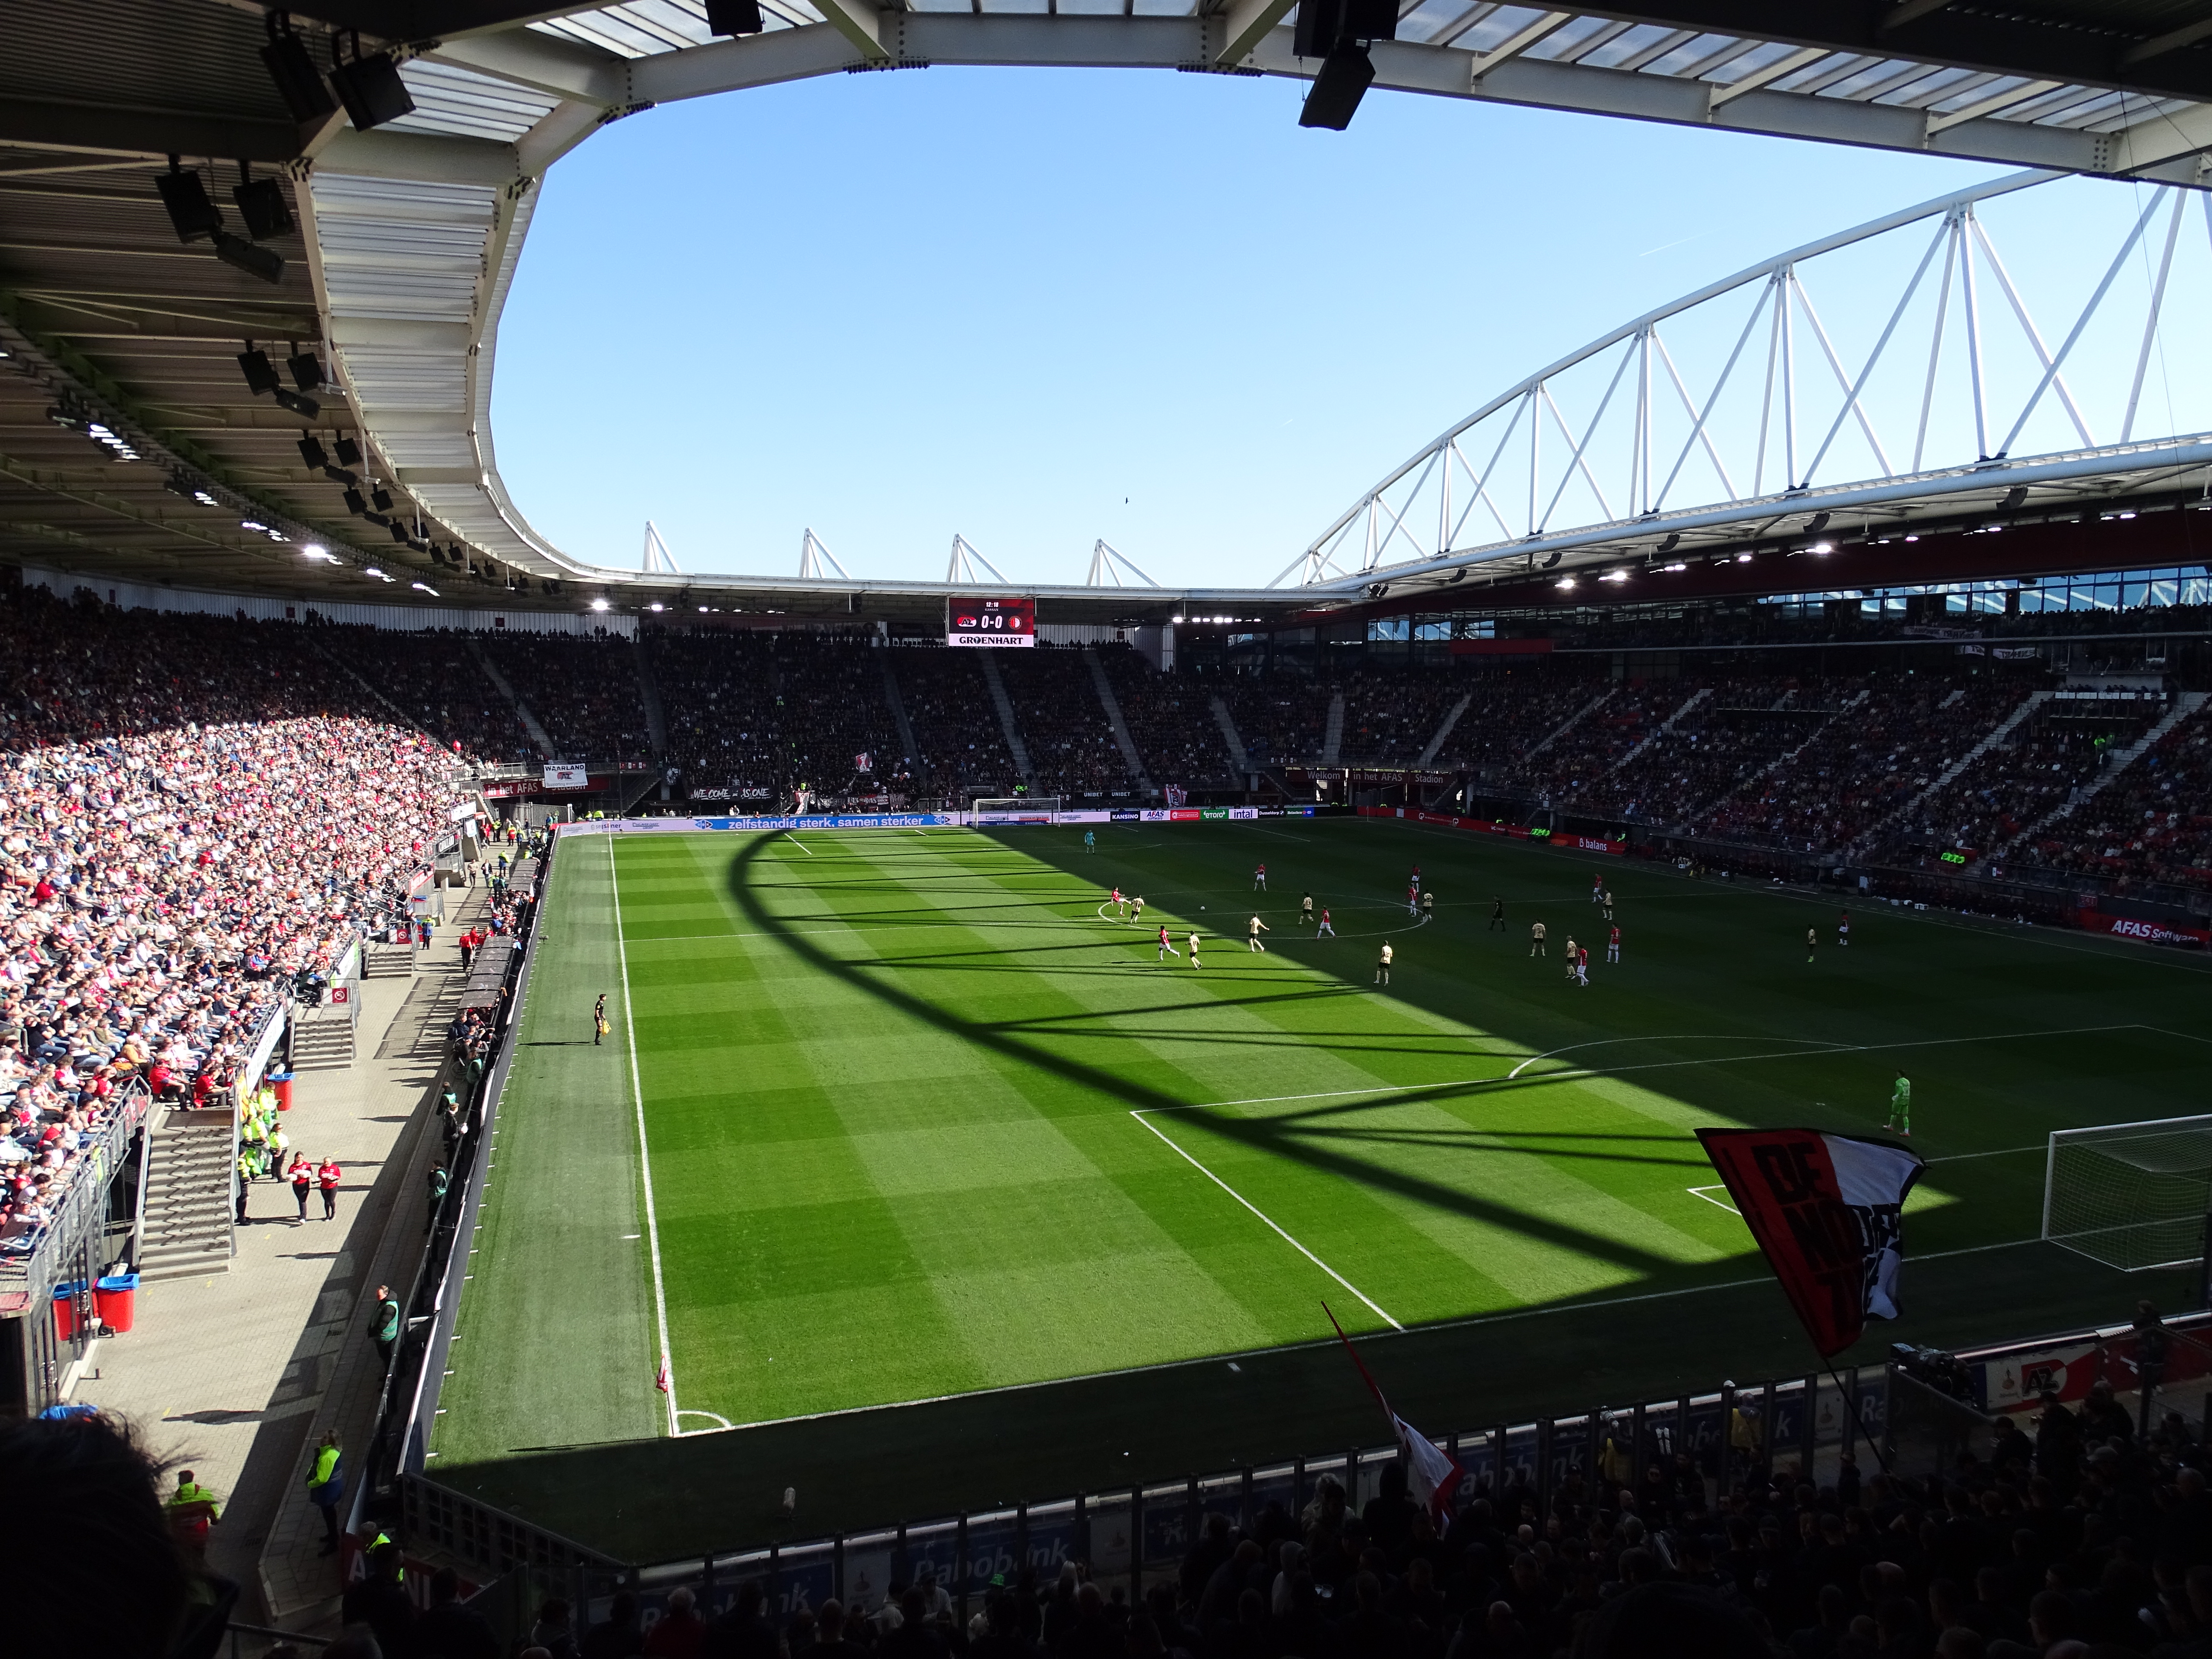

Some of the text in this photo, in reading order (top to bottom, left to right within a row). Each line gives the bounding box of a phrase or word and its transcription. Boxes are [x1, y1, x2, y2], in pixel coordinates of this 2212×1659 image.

[959, 636, 1024, 645] GROENHART
[1307, 771, 1443, 784] Welkom in het AFAS Stadion
[499, 784, 513, 795] het
[517, 783, 538, 793] AFAS
[752, 787, 770, 797] ONE
[1234, 809, 1253, 818] intal
[728, 818, 797, 829] zelfstandig
[838, 818, 878, 827] samen
[881, 815, 924, 826] sterker
[1586, 838, 1607, 851] balans
[2110, 920, 2152, 937] AFAS
[2022, 1366, 2060, 1397] AZ
